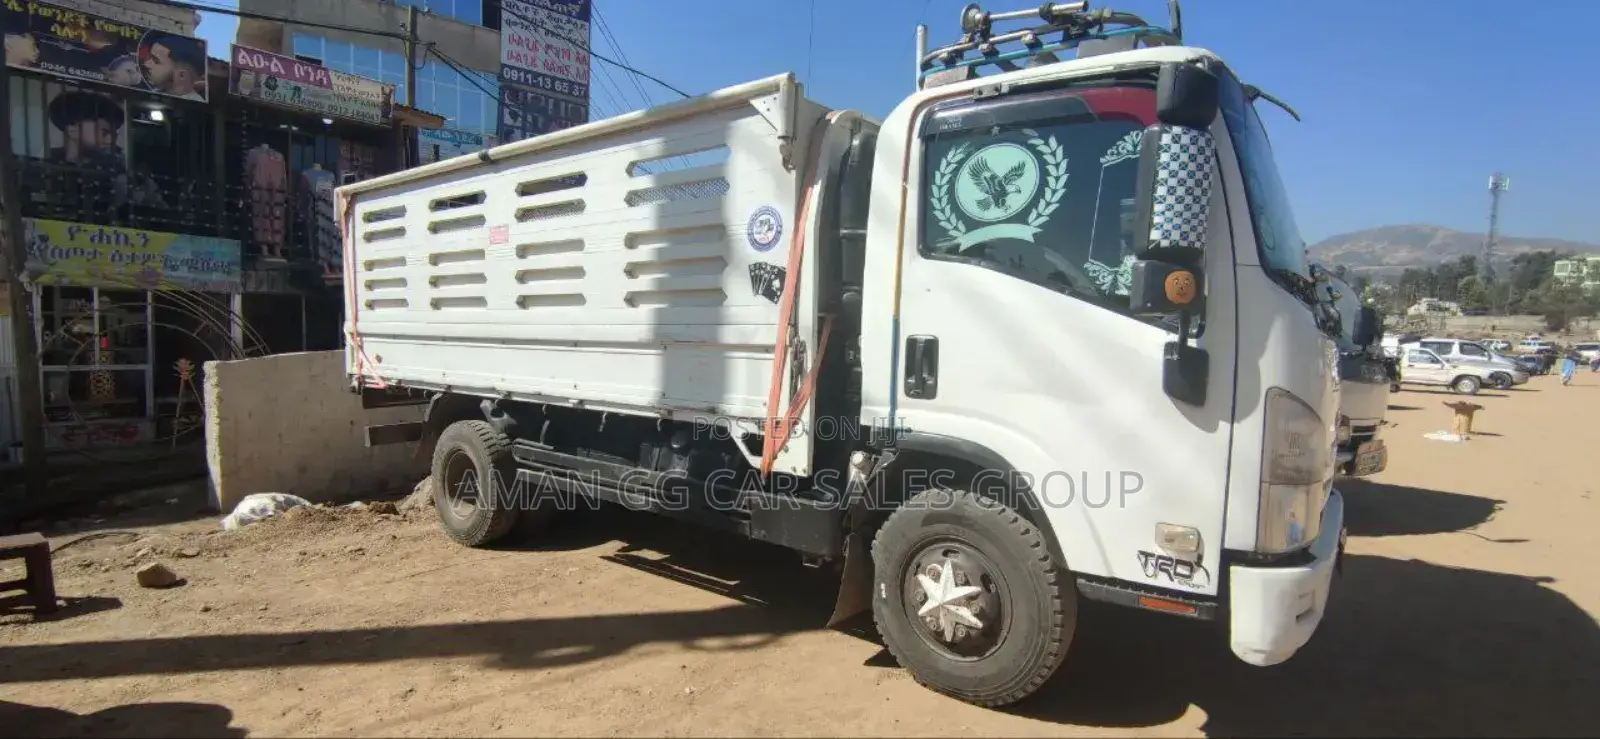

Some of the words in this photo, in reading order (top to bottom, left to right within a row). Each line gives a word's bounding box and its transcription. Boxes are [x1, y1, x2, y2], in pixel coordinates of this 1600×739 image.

[238, 48, 286, 75] ልዑል
[503, 67, 551, 89] 0911-13
[554, 80, 569, 94] 65
[572, 84, 587, 97] 37
